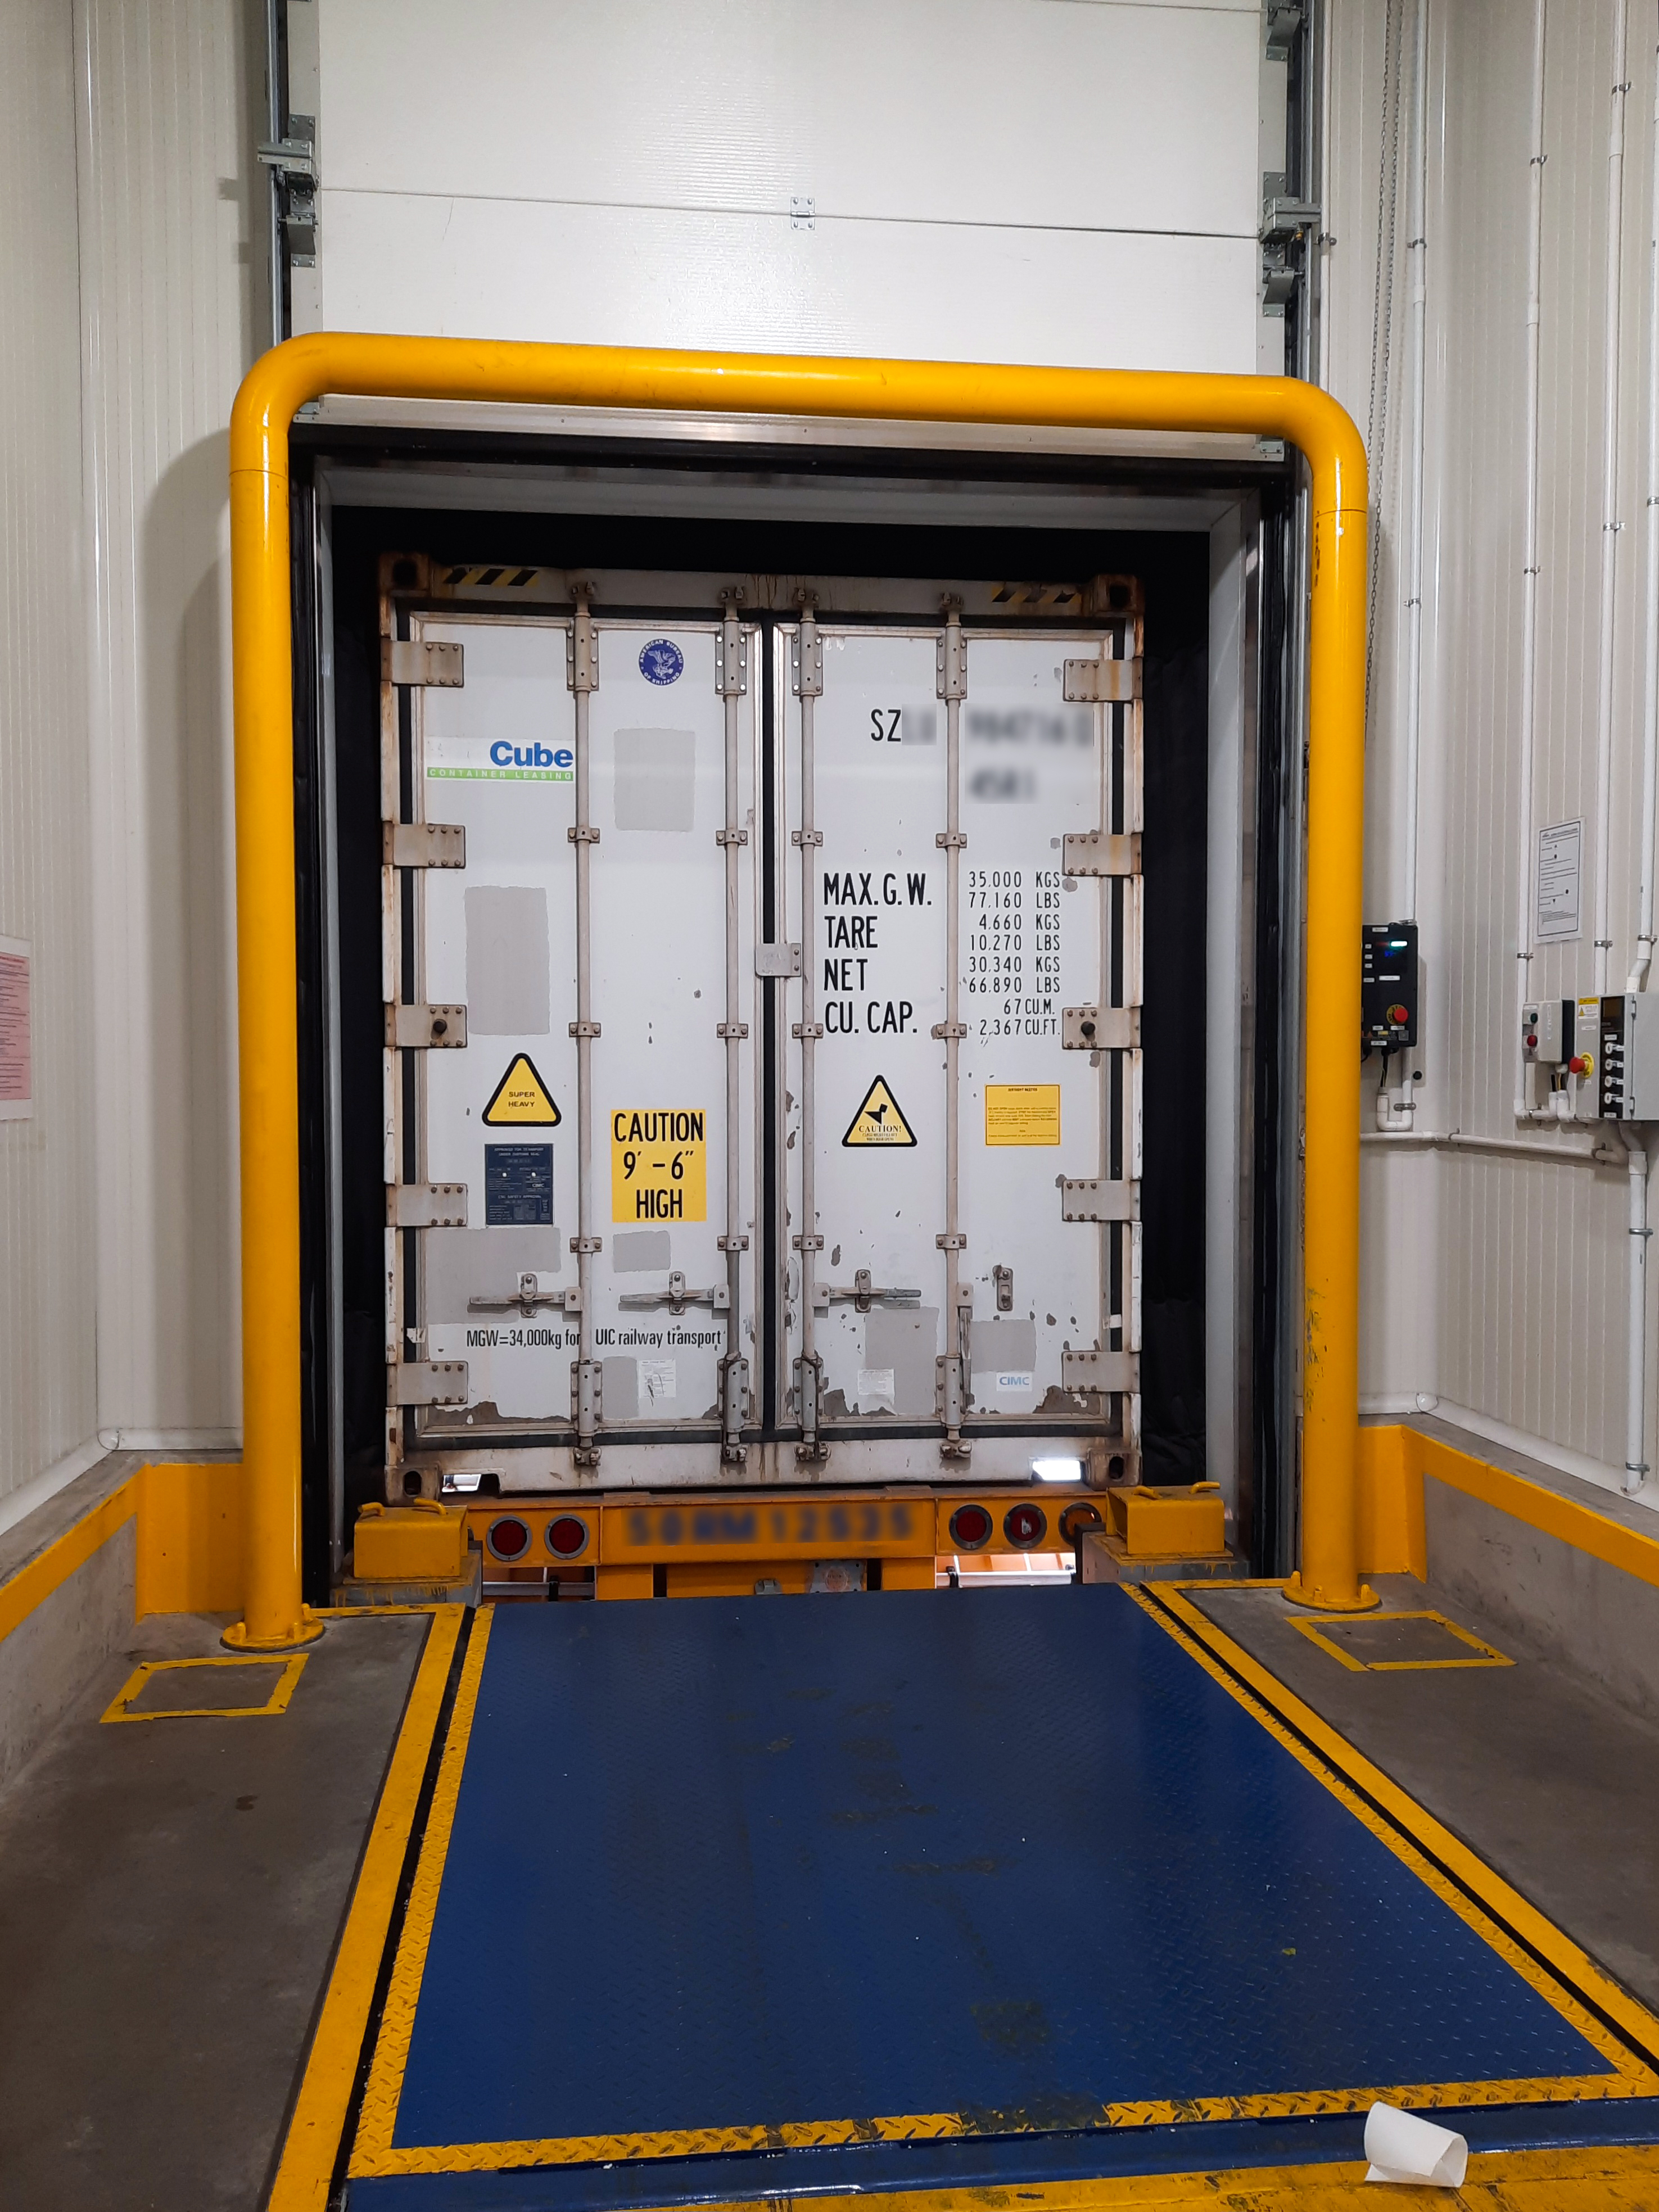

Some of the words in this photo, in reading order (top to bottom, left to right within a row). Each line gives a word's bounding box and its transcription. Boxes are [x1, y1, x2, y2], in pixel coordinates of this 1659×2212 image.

[640, 640, 663, 663] AMERICAN
[666, 641, 683, 663] BUREAU
[490, 740, 573, 767] Cube
[429, 769, 506, 778] CONTAINER
[515, 770, 571, 780] LEASING
[969, 871, 1022, 888] 35,000
[1036, 871, 1060, 888] KGS
[969, 892, 1022, 908] 77,160
[1037, 892, 1060, 908] LBS
[979, 913, 1022, 930] 4,660
[1036, 913, 1060, 930] KGS
[824, 916, 878, 948] TARE
[971, 935, 1022, 951] 10,270
[1037, 935, 1060, 951] LBS
[969, 956, 1022, 972] 30,340
[1036, 956, 1060, 972] KGS
[824, 958, 868, 991] NET
[969, 977, 1022, 993] 66,890
[1037, 977, 1060, 993] LBS
[1003, 998, 1021, 1015] 67
[825, 1001, 859, 1034] CU.
[867, 1001, 917, 1033] CAP.
[980, 1019, 1021, 1035] 2,367
[614, 1112, 703, 1142] CAUTION
[636, 1189, 682, 1219] HIGH
[467, 1329, 562, 1350] MGW=34,000kg
[565, 1329, 581, 1346] for
[595, 1328, 616, 1345] UIC
[618, 1328, 663, 1349] railway
[667, 1330, 721, 1349] transport
[999, 1376, 1030, 1386] CIMC
